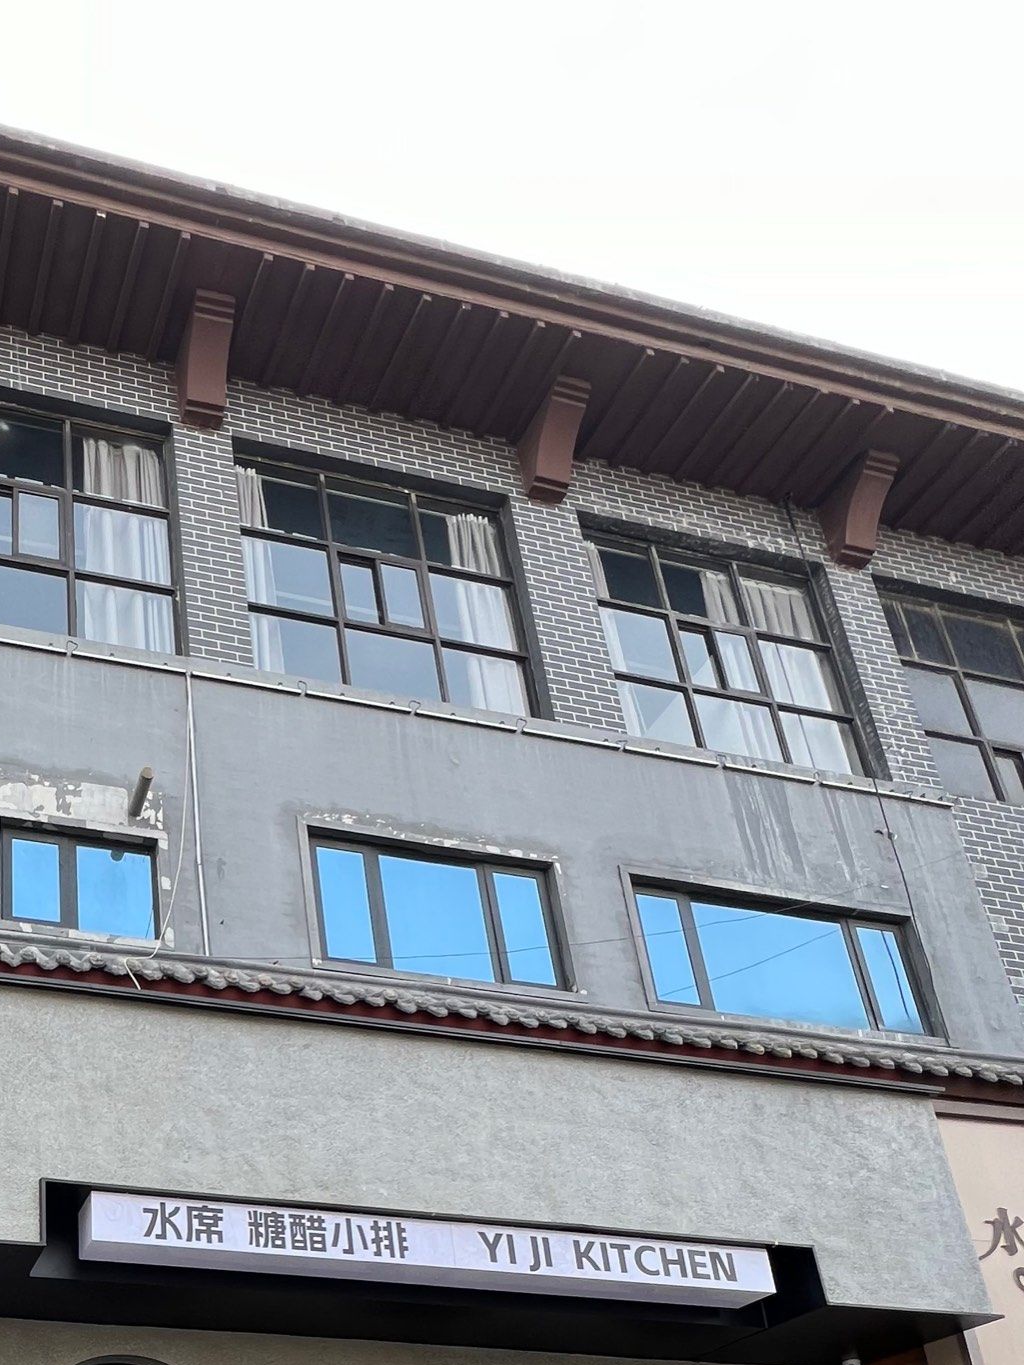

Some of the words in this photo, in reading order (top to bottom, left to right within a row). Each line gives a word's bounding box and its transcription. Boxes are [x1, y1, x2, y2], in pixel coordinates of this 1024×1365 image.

[143, 1202, 225, 1245] 水席
[248, 1209, 409, 1260] 糖醋小排
[477, 1230, 516, 1265] YI
[529, 1235, 556, 1270] JI
[575, 1239, 739, 1283] KITCHEN
